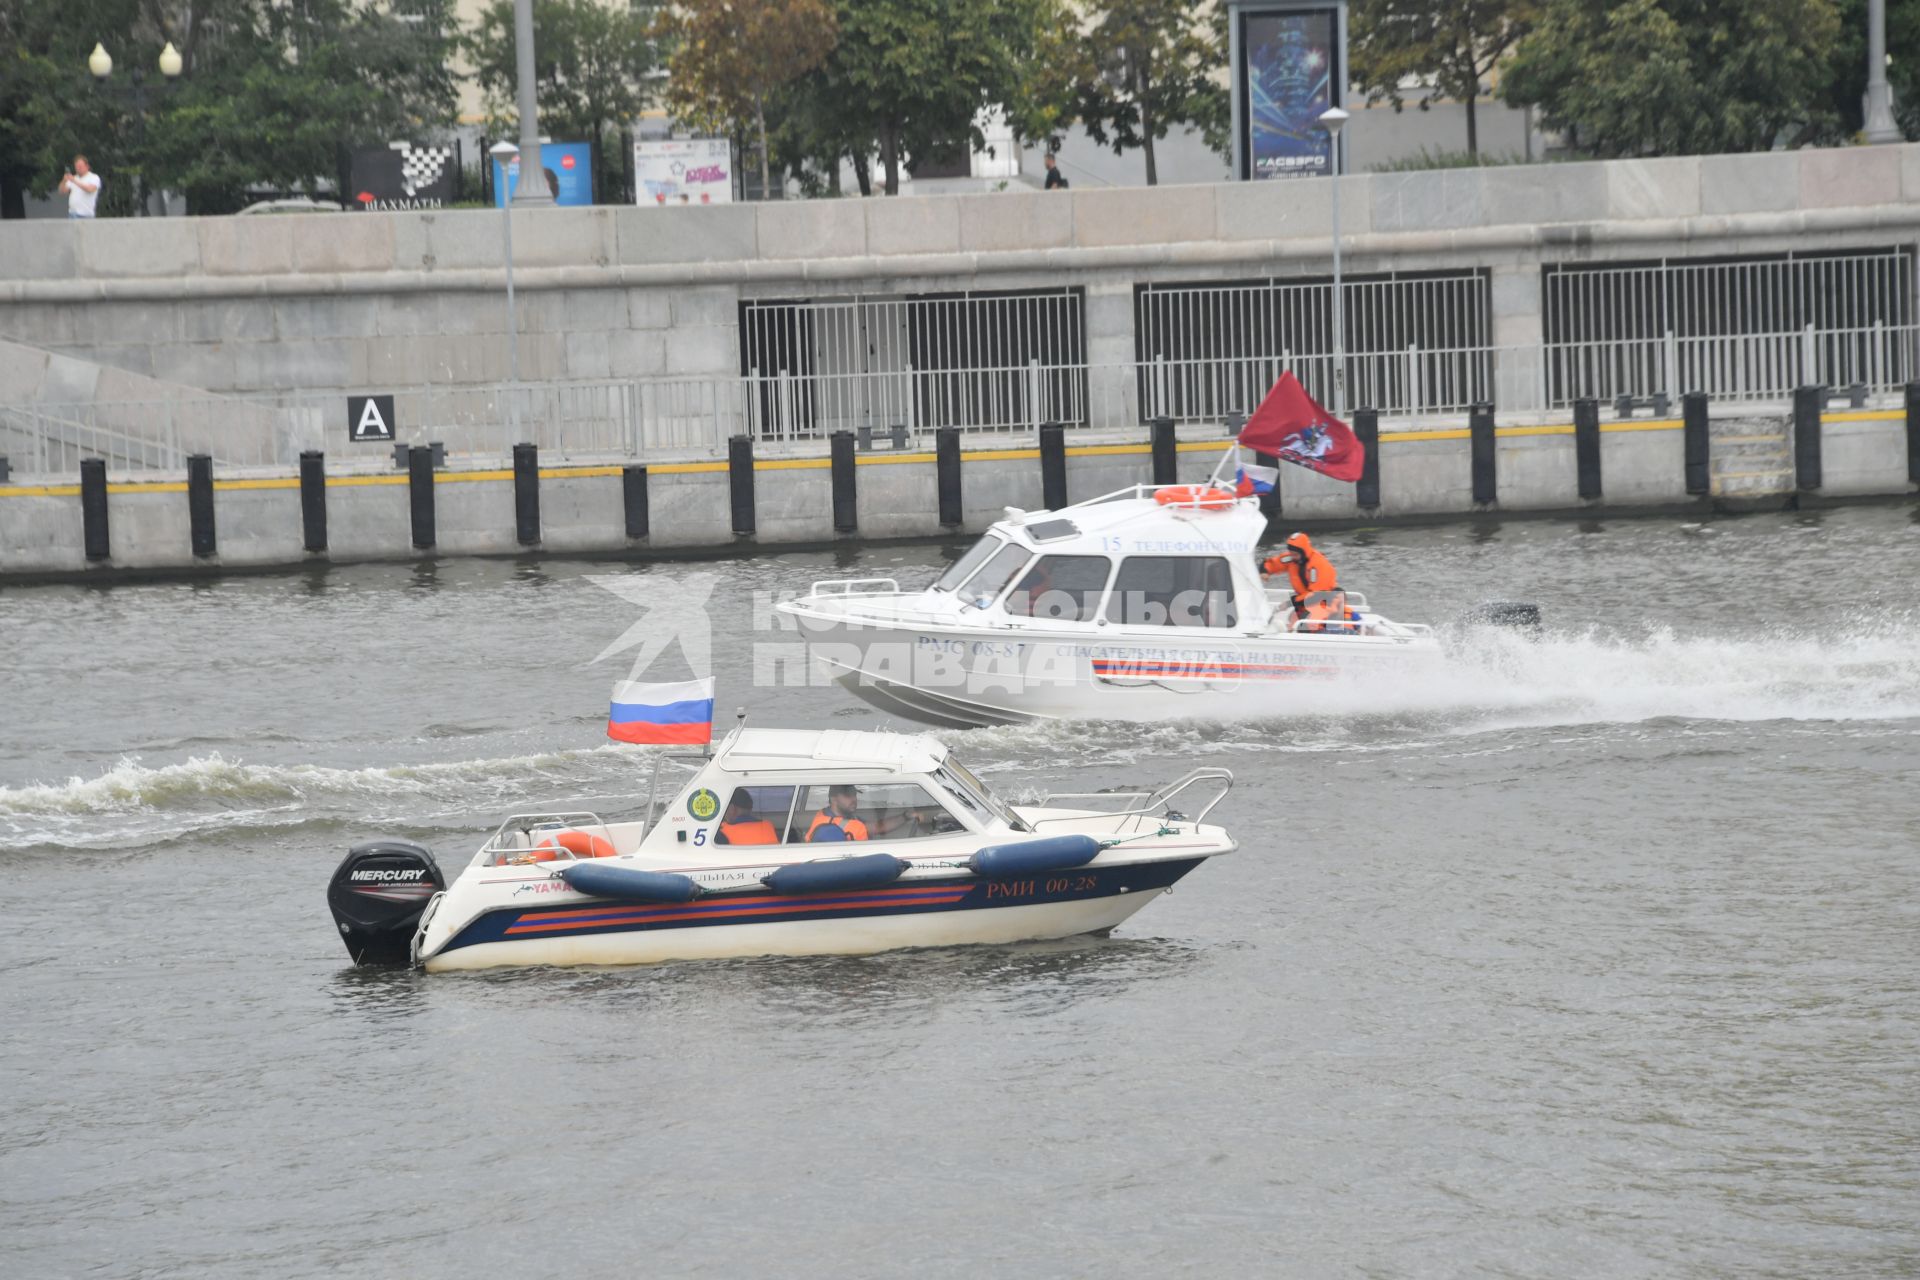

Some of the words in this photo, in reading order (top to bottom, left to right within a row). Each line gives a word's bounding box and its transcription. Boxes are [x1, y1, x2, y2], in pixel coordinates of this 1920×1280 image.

[365, 198, 443, 211] ШАХМАТЫ
[1102, 536, 1121, 552] 15
[918, 635, 966, 654] РМС
[972, 640, 1026, 658] 08-87
[693, 828, 708, 846] 5
[350, 869, 427, 881] MERCURY
[533, 881, 572, 894] YAMA
